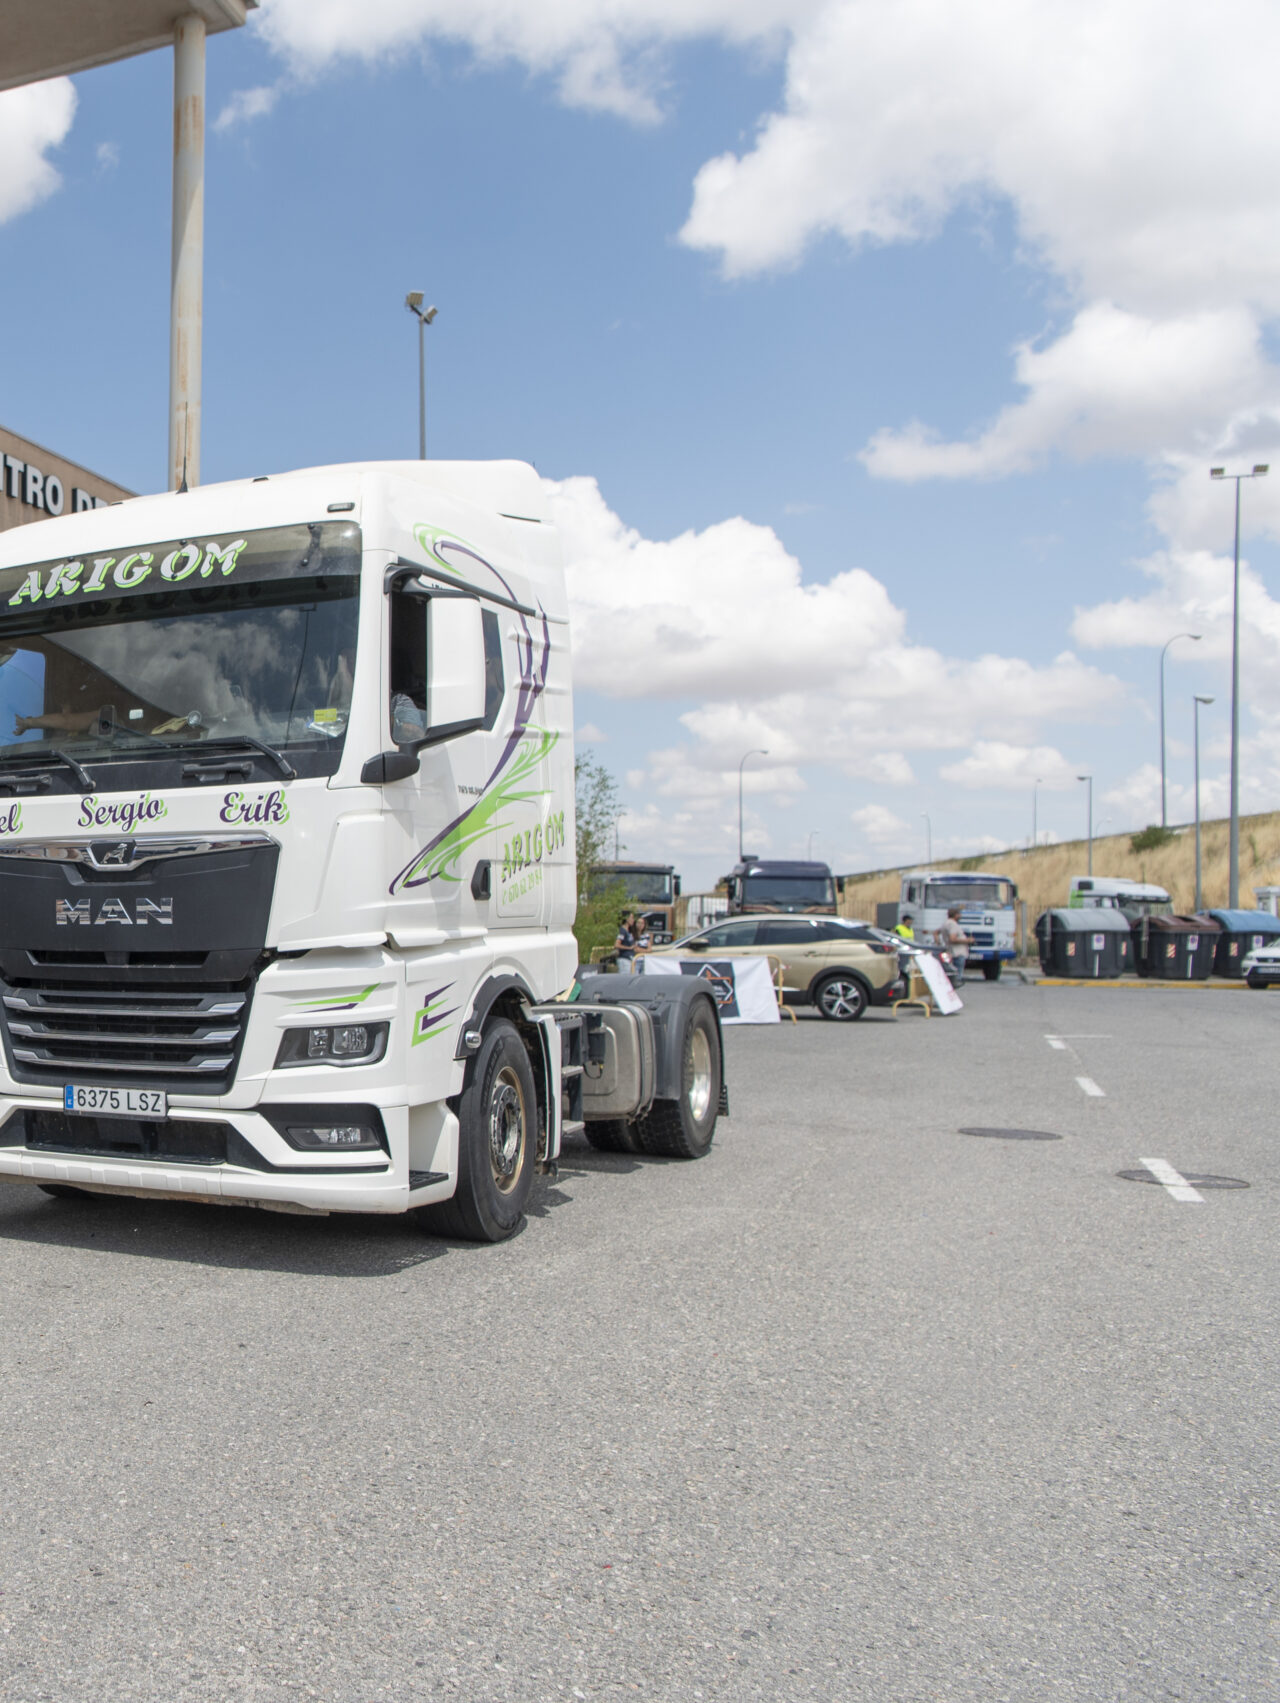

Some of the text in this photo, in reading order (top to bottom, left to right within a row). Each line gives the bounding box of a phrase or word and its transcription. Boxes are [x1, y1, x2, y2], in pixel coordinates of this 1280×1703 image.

[72, 487, 108, 513] D
[8, 539, 247, 606] ARIGOM
[77, 793, 168, 833] Sergio
[219, 790, 290, 826] Erik
[501, 810, 564, 883] ARIGOM
[55, 897, 173, 925] MAN
[77, 1089, 120, 1109] 6375
[127, 1092, 161, 1112] LSZ
